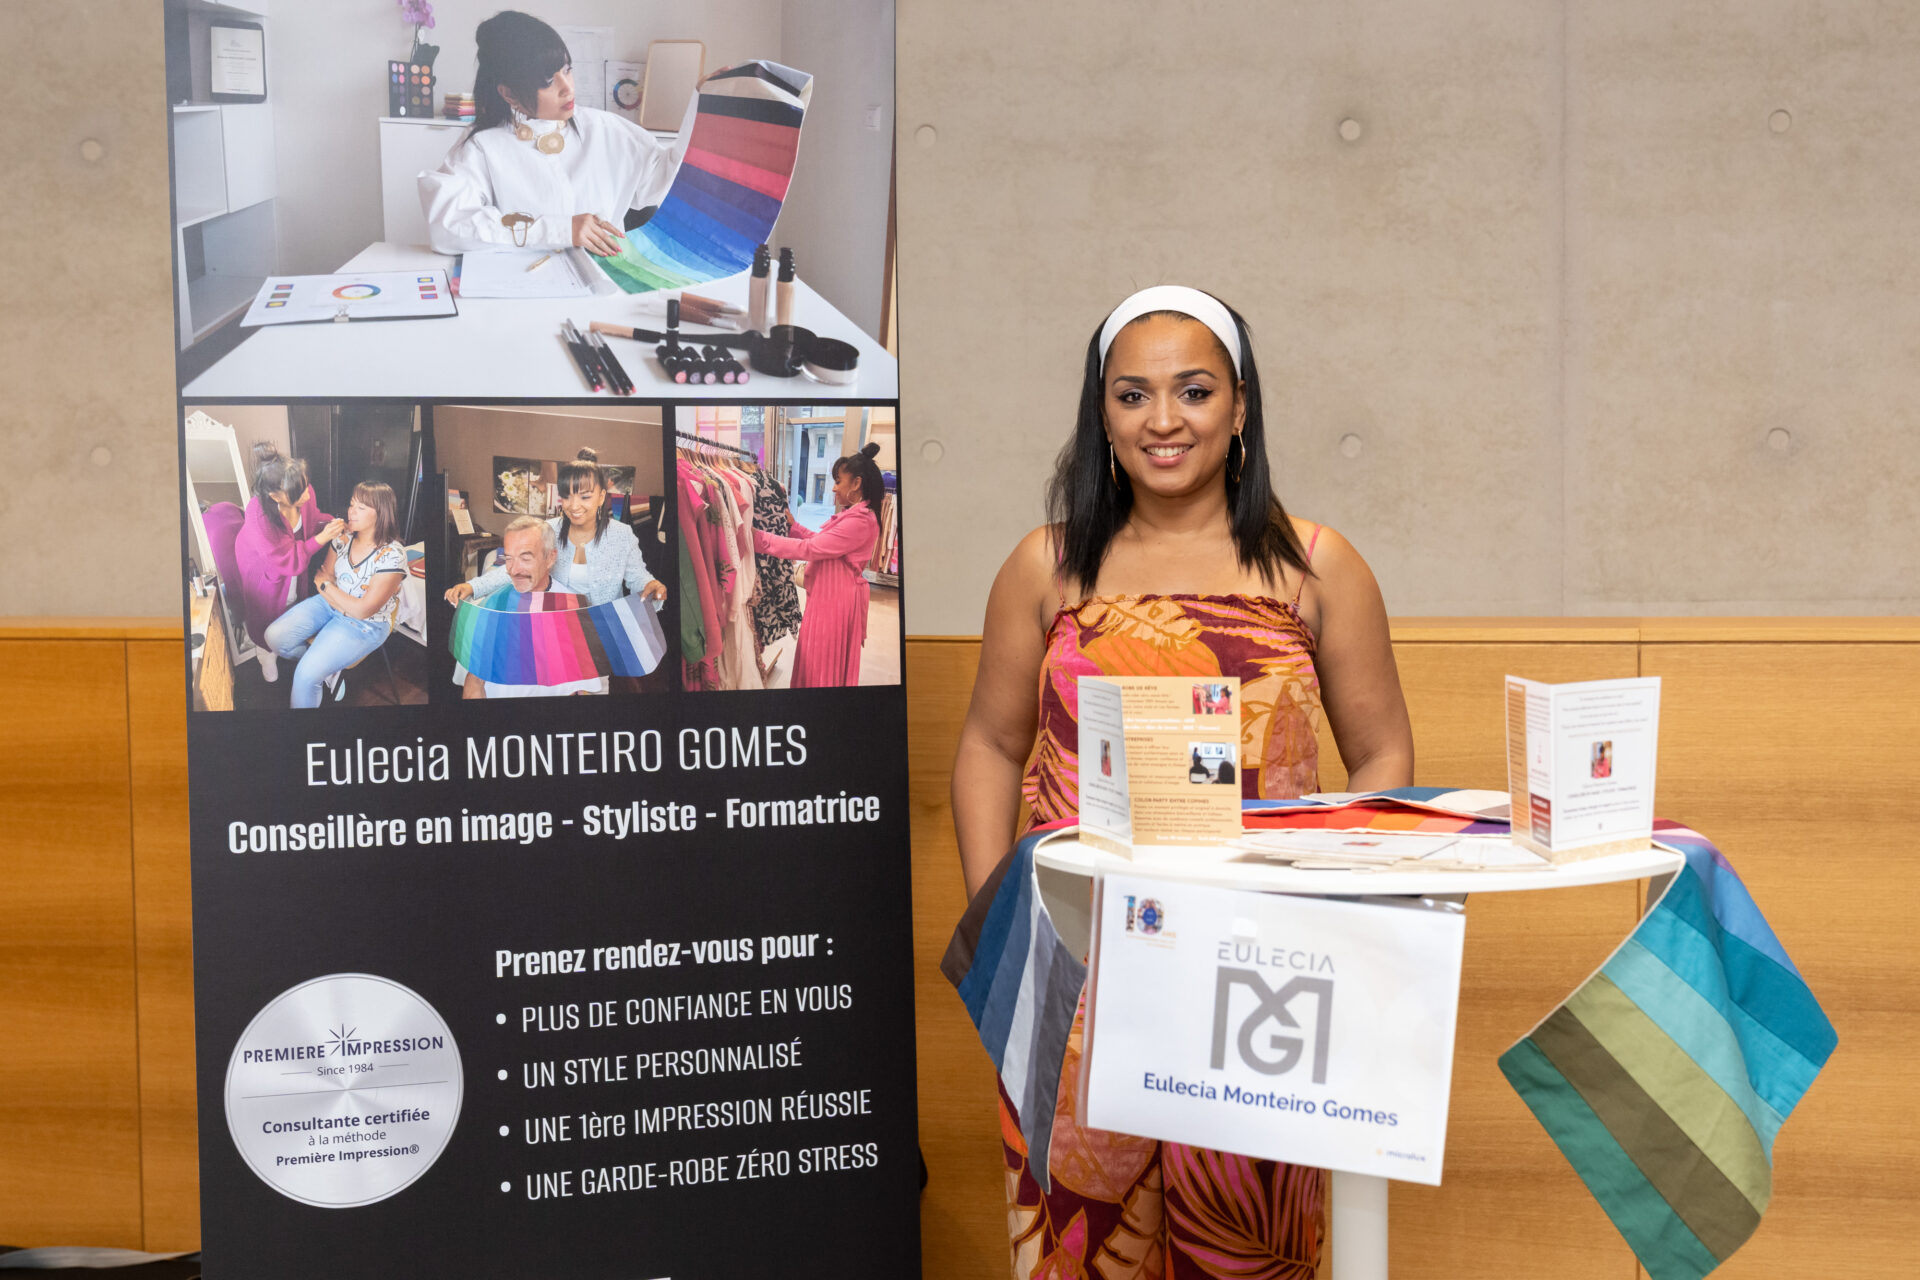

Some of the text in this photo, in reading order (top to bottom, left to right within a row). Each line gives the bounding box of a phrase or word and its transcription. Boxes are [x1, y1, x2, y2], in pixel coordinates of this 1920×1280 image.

[306, 725, 807, 786] Eulecia MONTEIRO GOMES
[228, 813, 406, 854] Conseillère
[416, 816, 452, 844] en
[462, 808, 552, 844] image
[583, 800, 696, 840] Styliste
[726, 790, 880, 828] Formatrice
[496, 949, 586, 978] Prenez
[593, 938, 754, 972] rendez-vous
[761, 933, 819, 964] pour
[1217, 941, 1335, 974] EULECIA
[522, 984, 852, 1032] PLUS DE CONFIANCE EN VOUS
[244, 1036, 444, 1064] PREMIERE IMPRESSION
[317, 1063, 374, 1076] Since 1984
[524, 1036, 802, 1089] UN STYLE PERSONNALISÉ
[262, 1108, 430, 1134] Consultante certifiée
[524, 1089, 872, 1145] UNE 1ère IMPRESSION RÉUSSIE
[1144, 1072, 1398, 1126] Eulecia Monteiro Gomes
[276, 1144, 420, 1166] Première Impression®
[308, 1130, 386, 1146] à la méthode
[527, 1142, 879, 1200] UNE GARDE-ROBE ZÉRO STRESS
